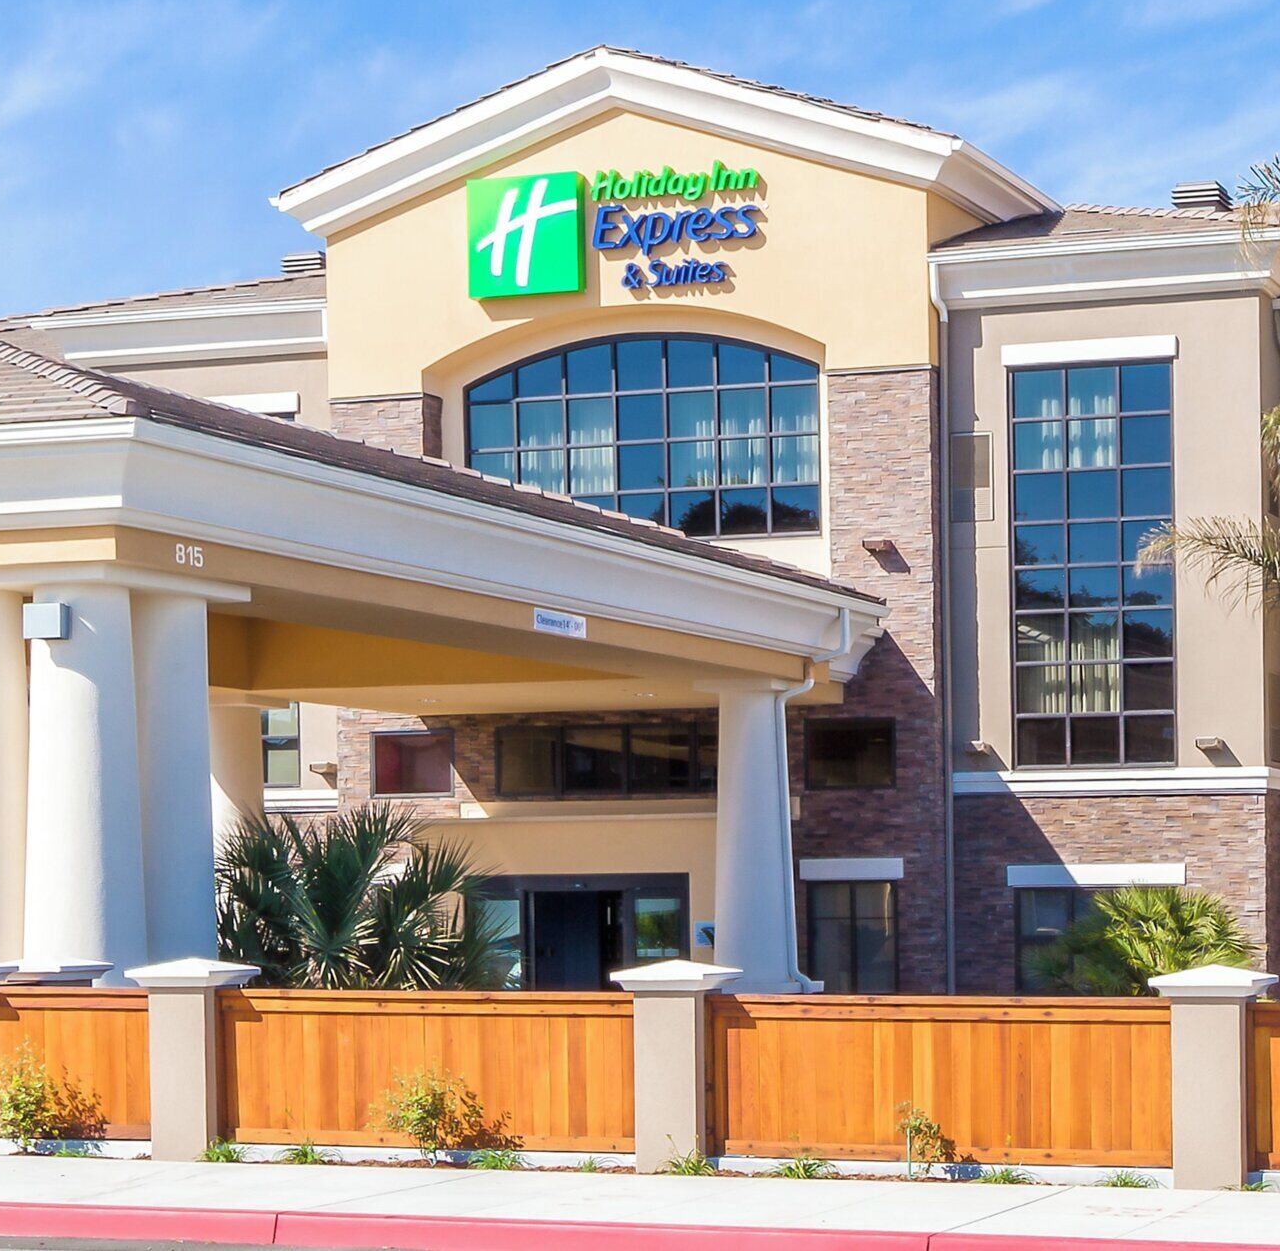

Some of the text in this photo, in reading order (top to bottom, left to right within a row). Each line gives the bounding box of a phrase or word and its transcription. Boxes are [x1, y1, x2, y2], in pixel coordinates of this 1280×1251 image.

[590, 159, 759, 201] Holiday Inn
[477, 179, 577, 287] H
[592, 205, 758, 255] Express
[621, 259, 726, 289] & Suites
[176, 543, 204, 567] 815
